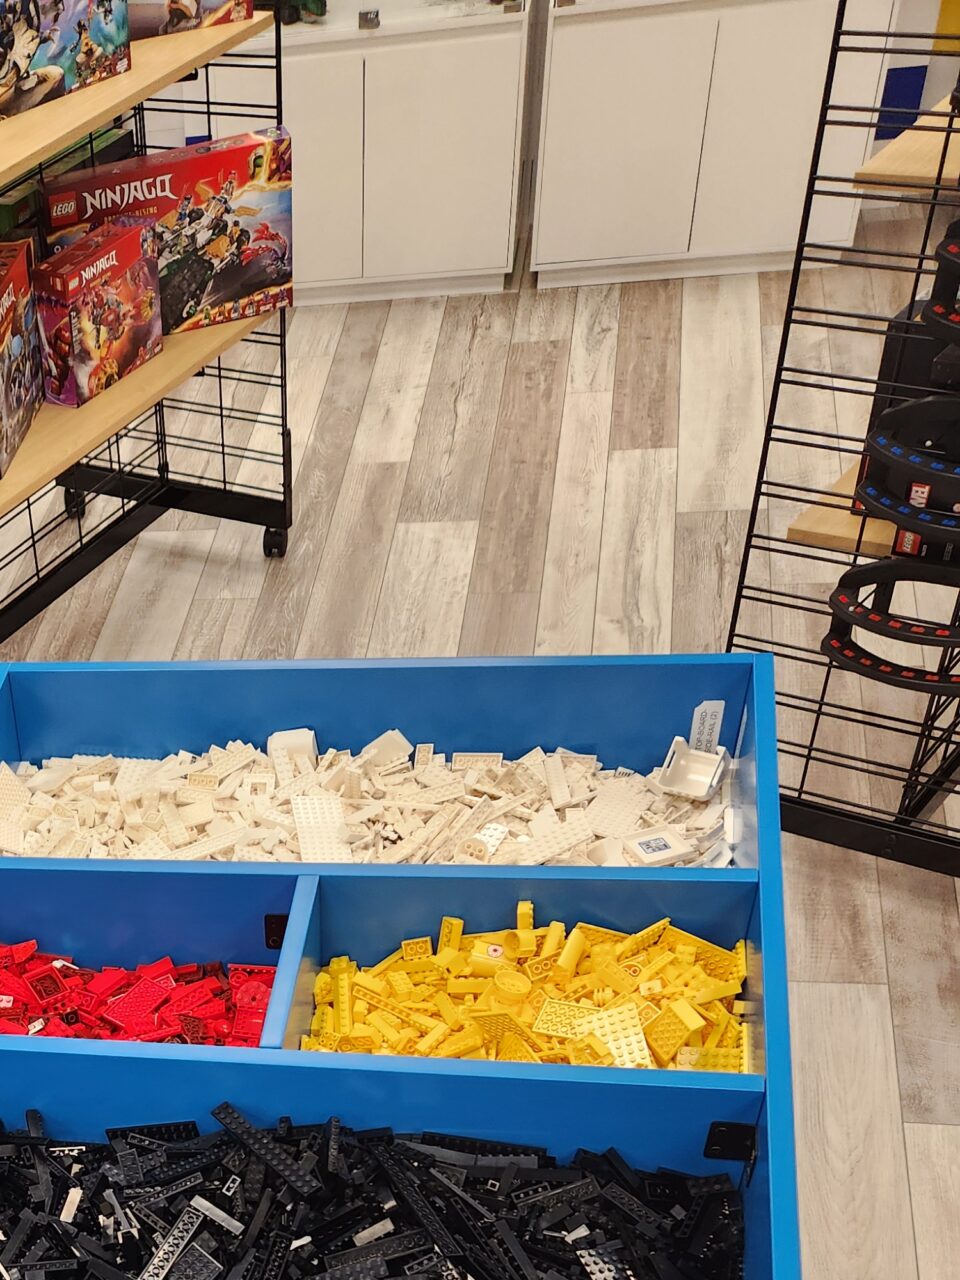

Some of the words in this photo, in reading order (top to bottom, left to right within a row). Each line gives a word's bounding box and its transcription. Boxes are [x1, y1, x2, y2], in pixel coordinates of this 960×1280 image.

[52, 201, 76, 217] LEGO
[81, 173, 179, 220] NINJAGO
[80, 250, 119, 288] NINJAGO
[903, 533, 915, 552] LEGO
